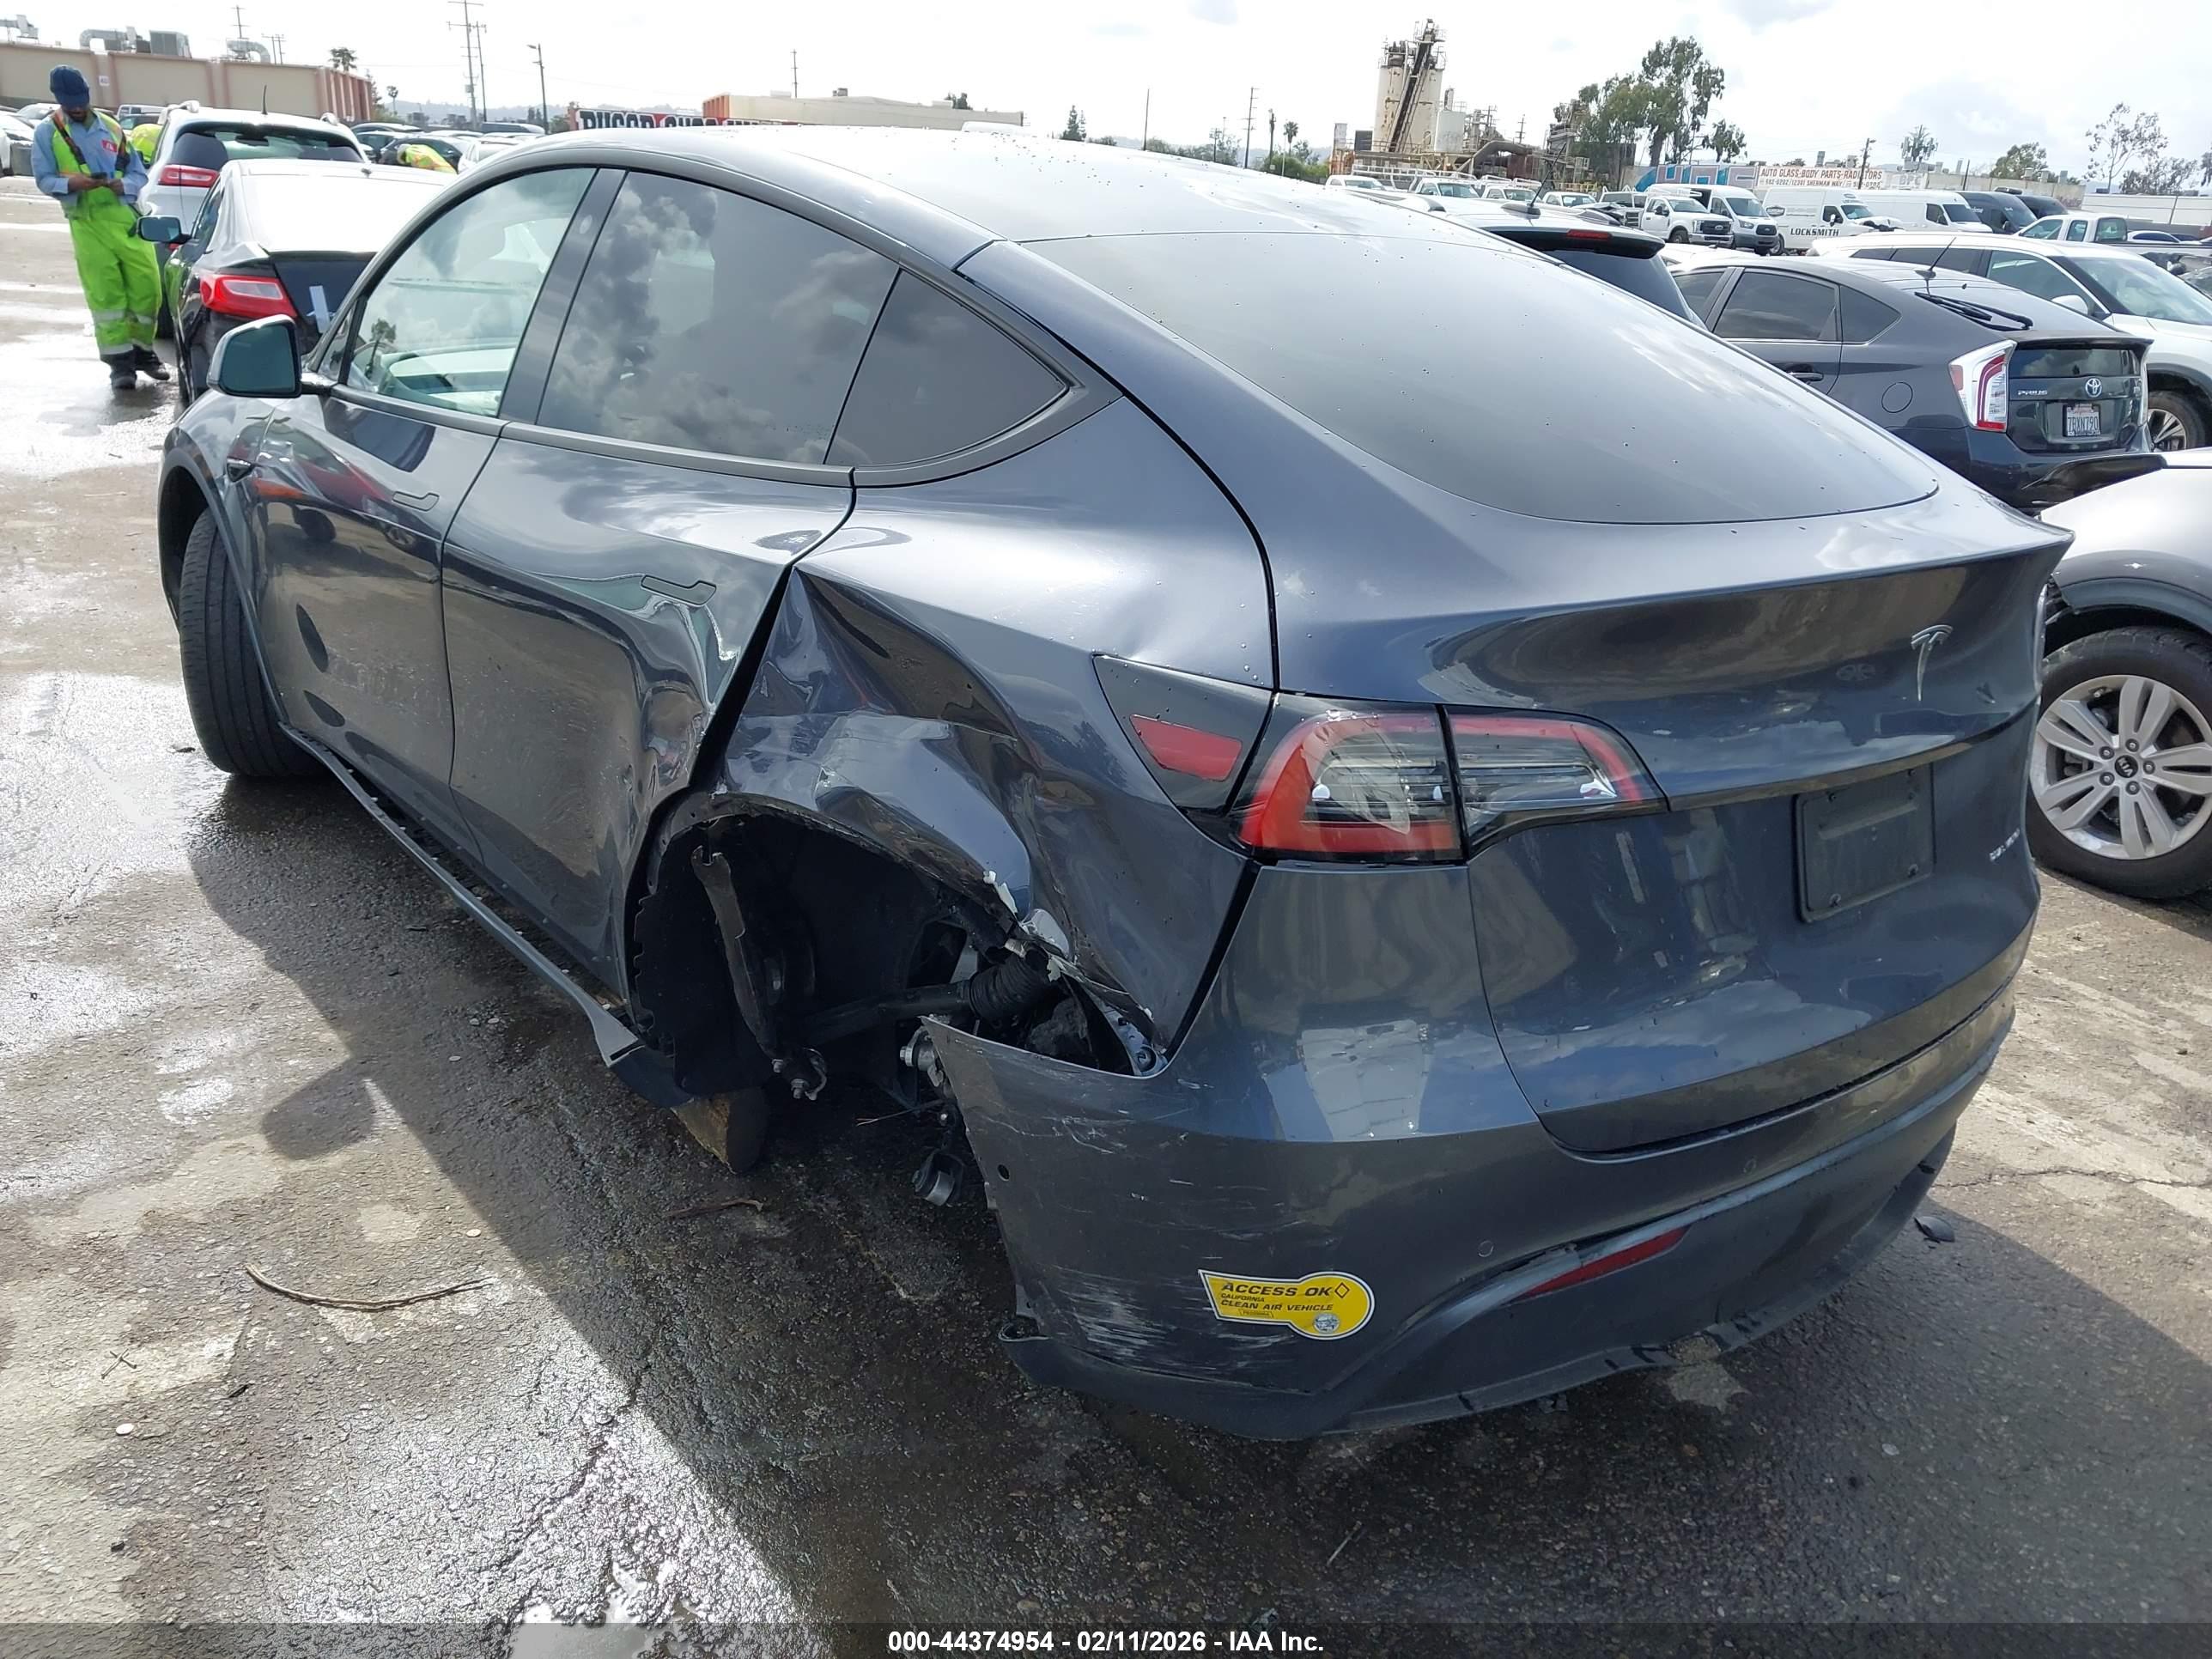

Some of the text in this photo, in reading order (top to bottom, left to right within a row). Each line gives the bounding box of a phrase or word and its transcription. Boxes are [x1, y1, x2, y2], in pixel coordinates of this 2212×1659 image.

[1761, 168, 1778, 178] AUTO
[1790, 228, 1839, 236] LOCKSMITH
[1221, 1282, 1333, 1297] ACCESS OK
[1221, 1292, 1265, 1303] CALIFORNIA
[1220, 1299, 1259, 1310] CLEAN
